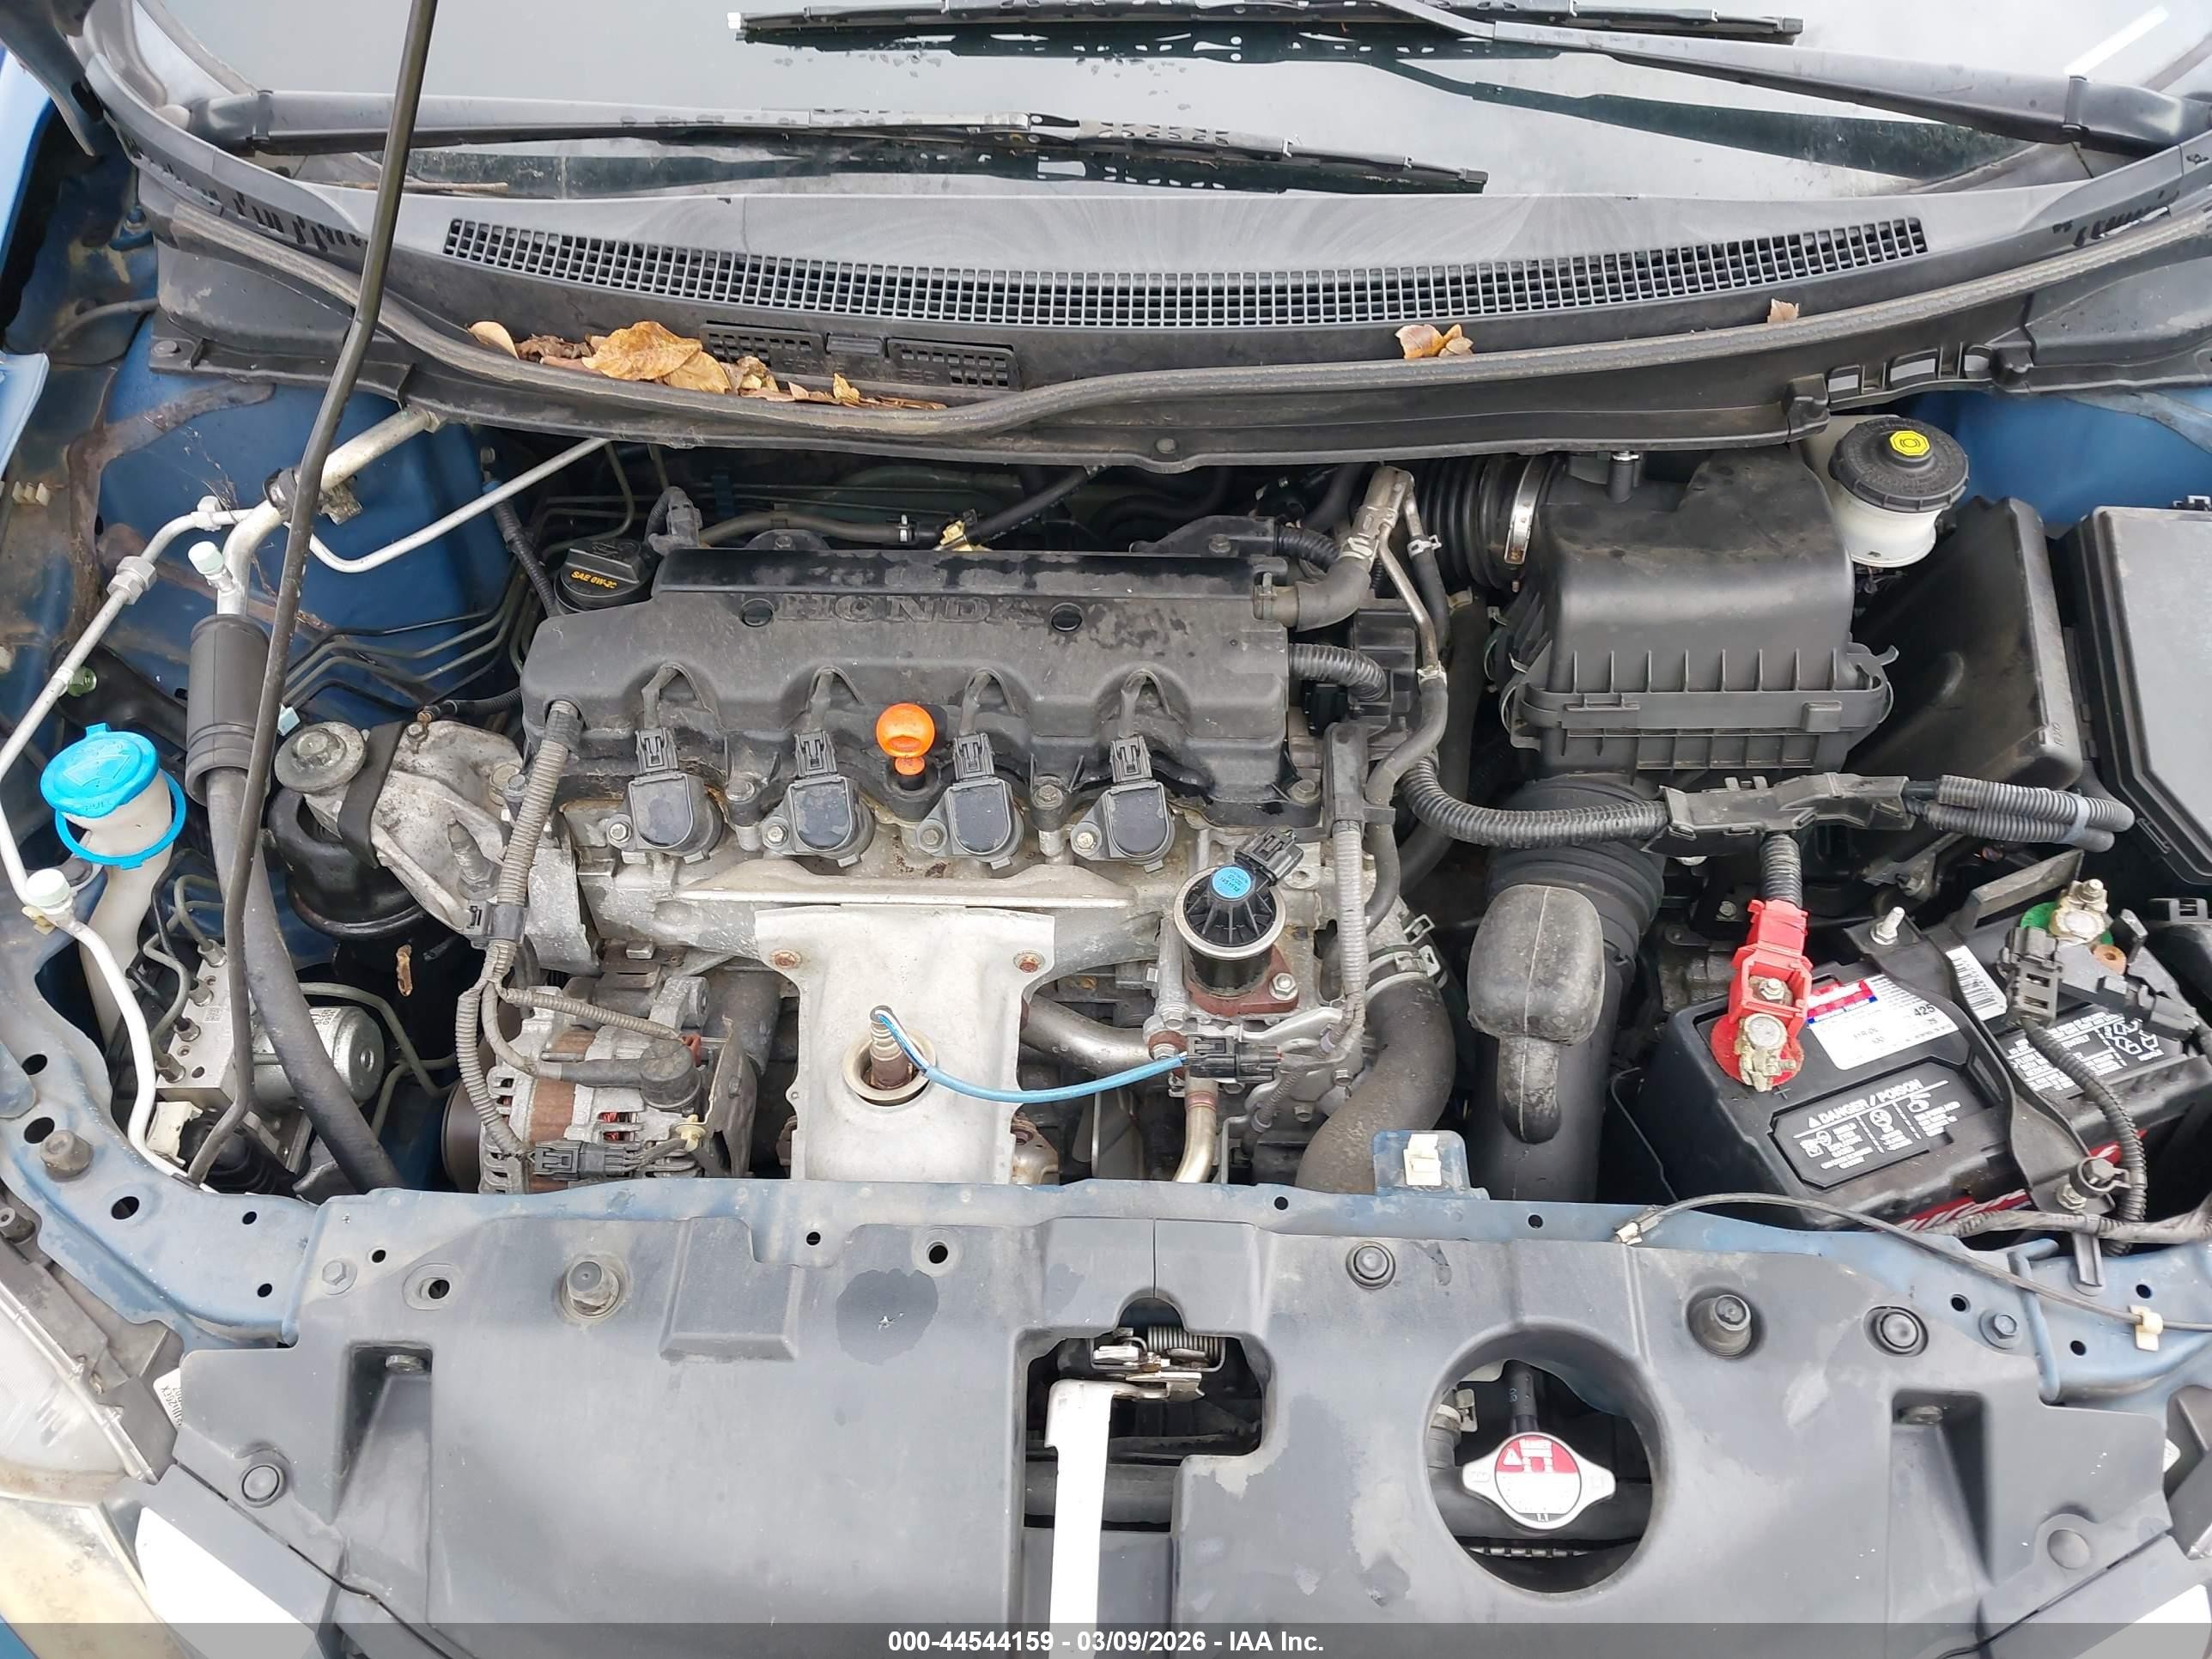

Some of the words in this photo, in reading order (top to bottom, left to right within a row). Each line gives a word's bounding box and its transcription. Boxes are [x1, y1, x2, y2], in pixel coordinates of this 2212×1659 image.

[571, 571, 591, 581] SAE
[773, 592, 1045, 625] HONDA
[1913, 1003, 1936, 1018] 425
[1817, 1098, 1870, 1124] DANGER
[1875, 1079, 1924, 1103] POISON
